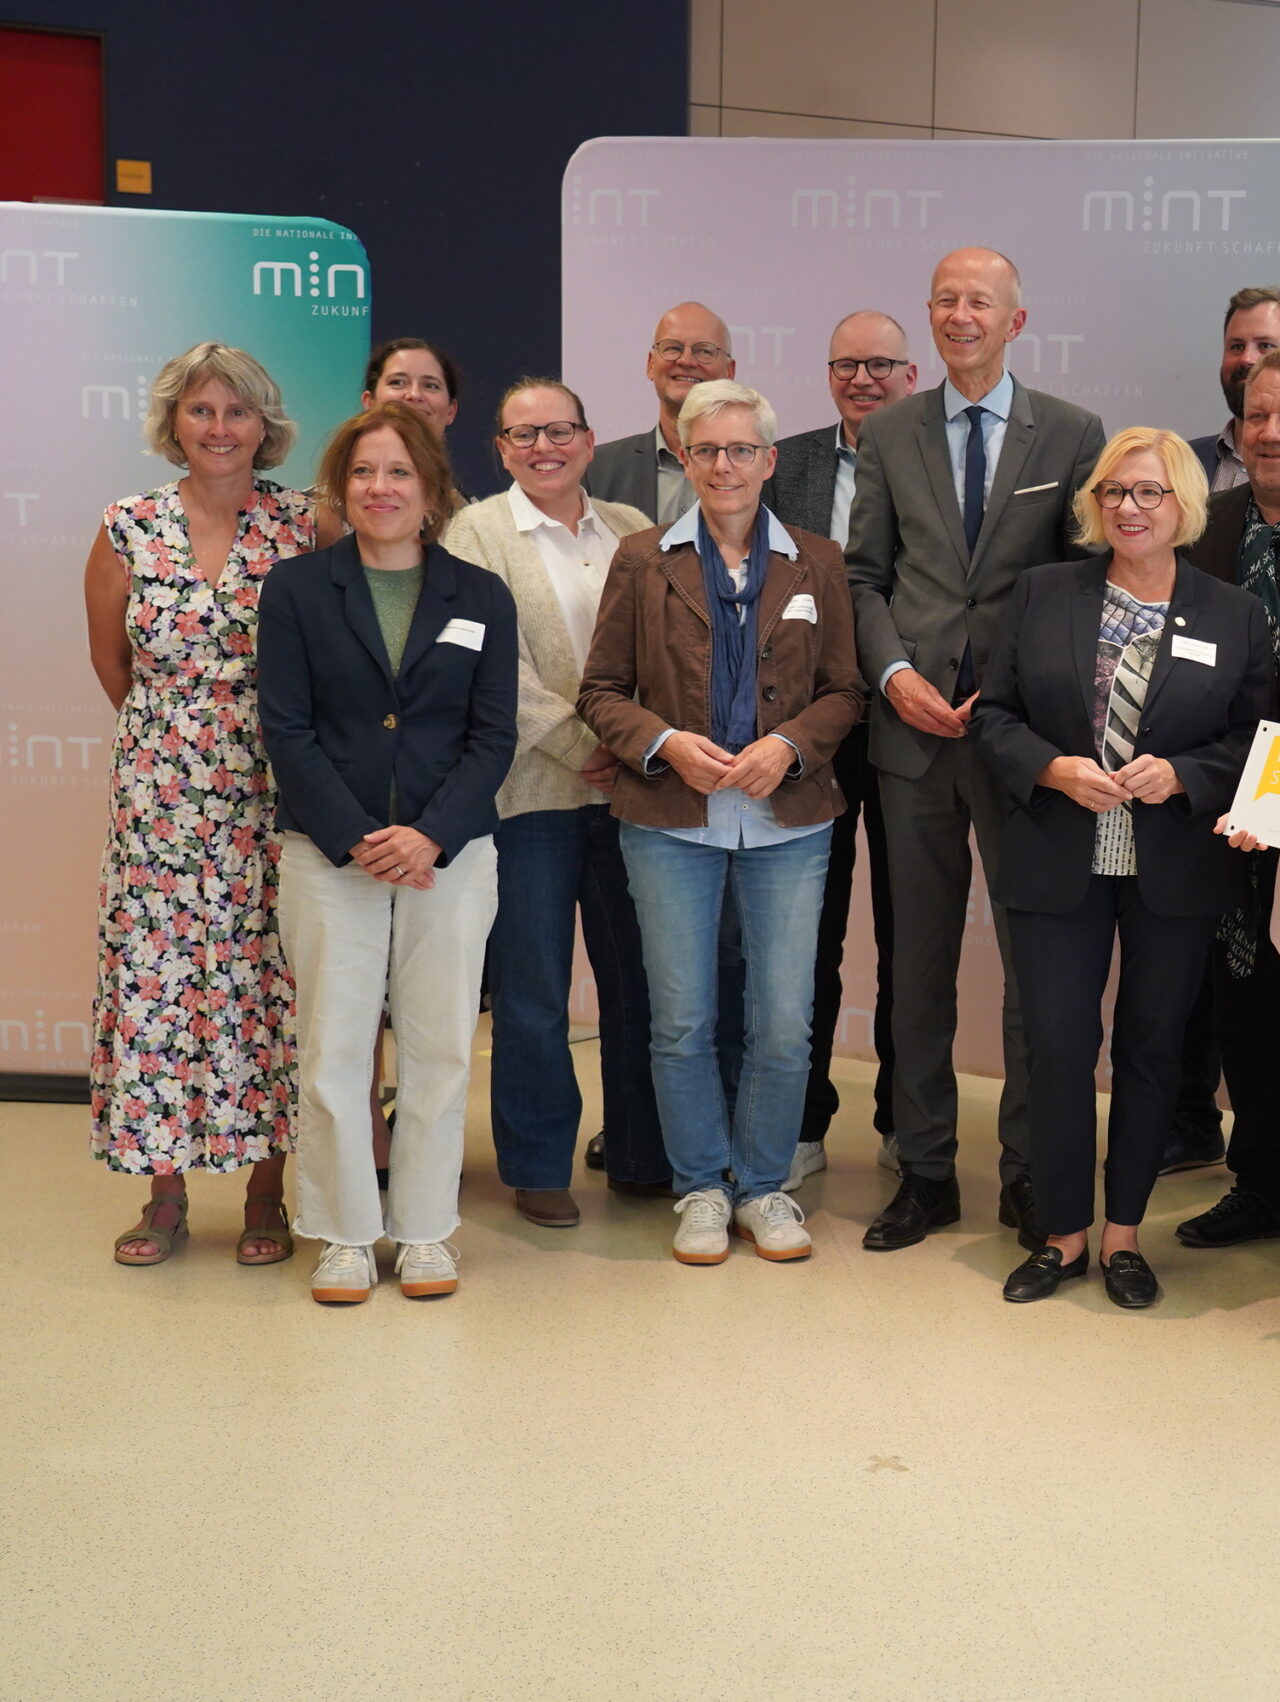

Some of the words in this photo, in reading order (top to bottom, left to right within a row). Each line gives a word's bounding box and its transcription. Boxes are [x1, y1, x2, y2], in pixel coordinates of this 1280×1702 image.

[252, 228, 272, 237] DIE
[275, 229, 336, 240] NATIONALE
[1143, 240, 1216, 254] ZUKUNFT
